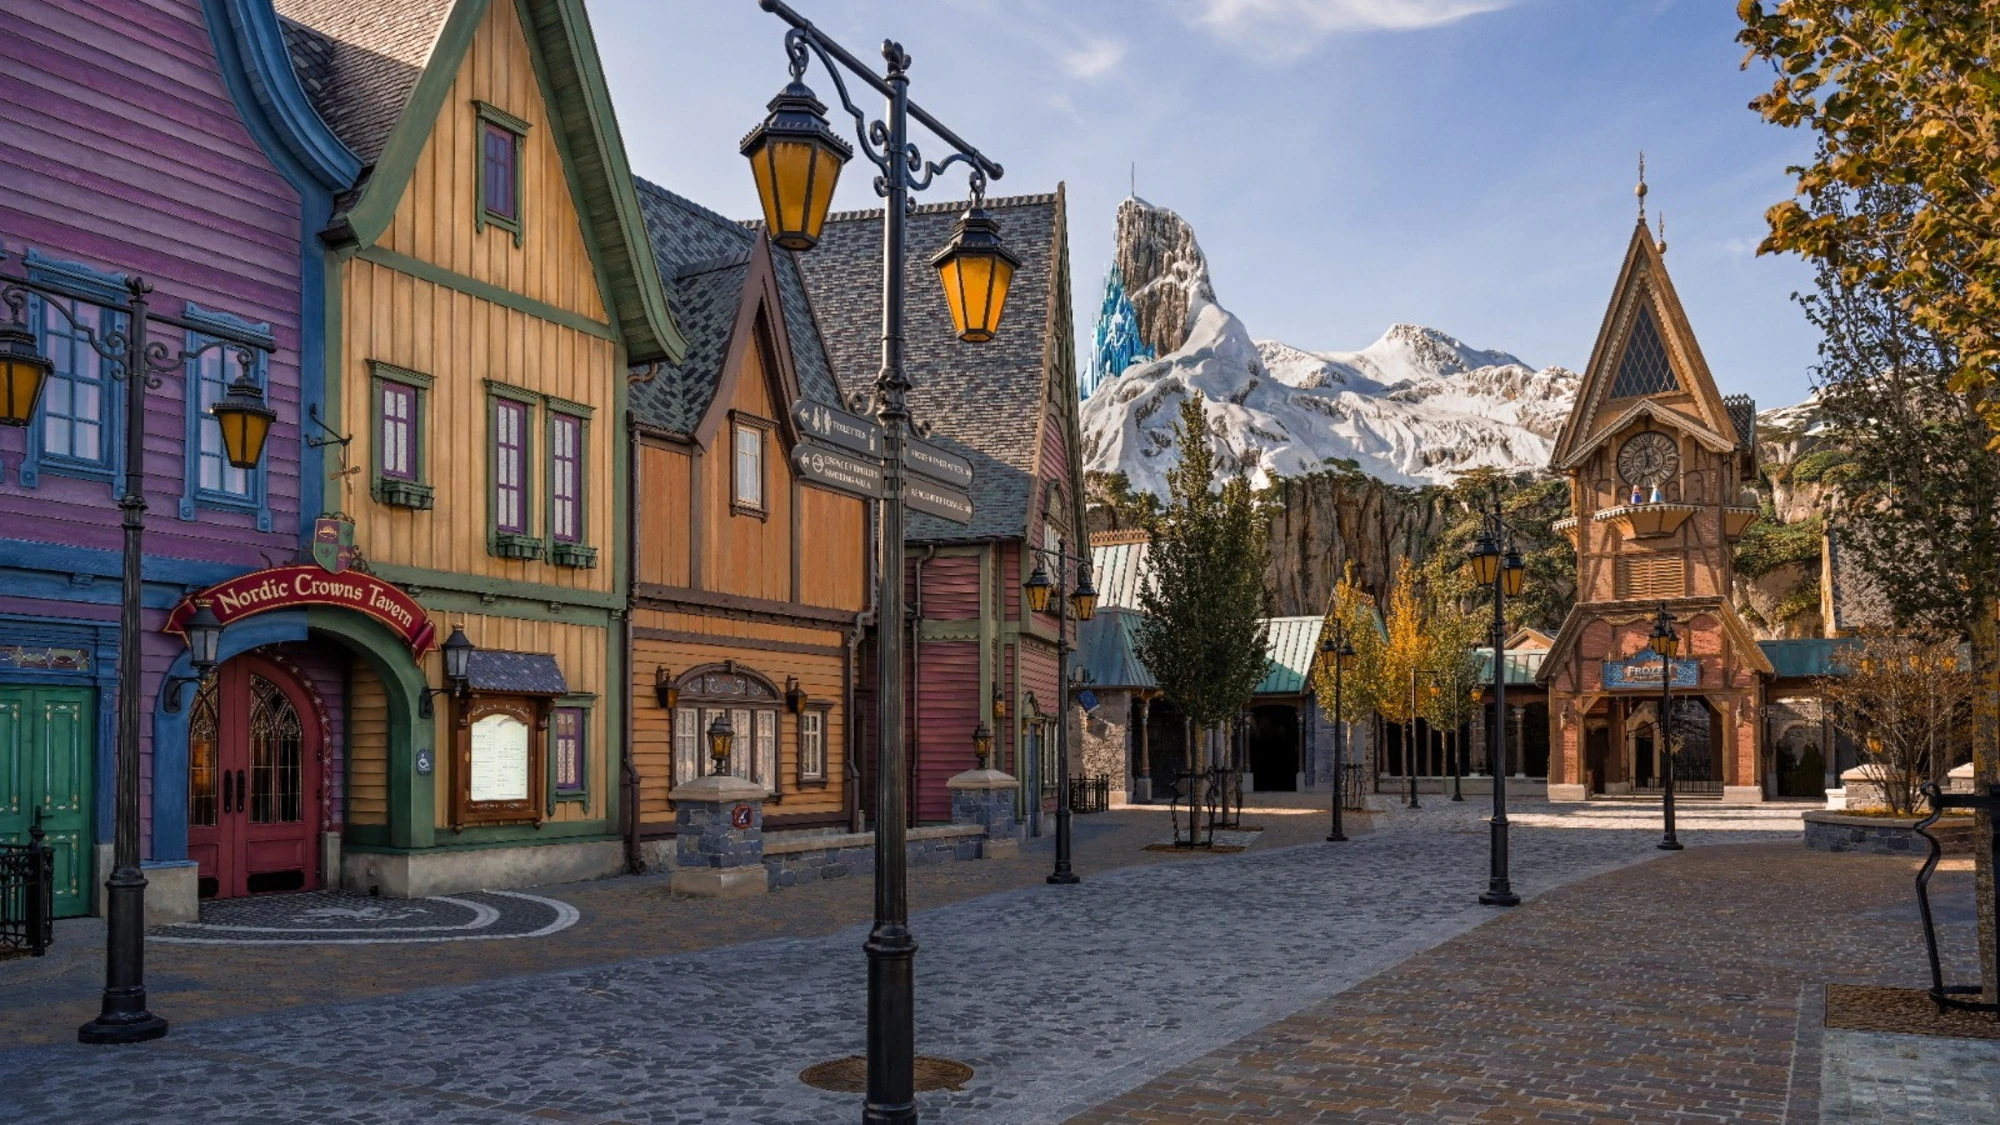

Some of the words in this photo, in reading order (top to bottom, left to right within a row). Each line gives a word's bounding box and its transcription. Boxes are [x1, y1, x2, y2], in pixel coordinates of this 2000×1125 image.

[832, 420, 866, 440] TOILETTES
[824, 468, 855, 484] SMOKING
[216, 579, 289, 614] Nordic
[294, 573, 363, 600] Crowns
[368, 583, 413, 628] Tavern
